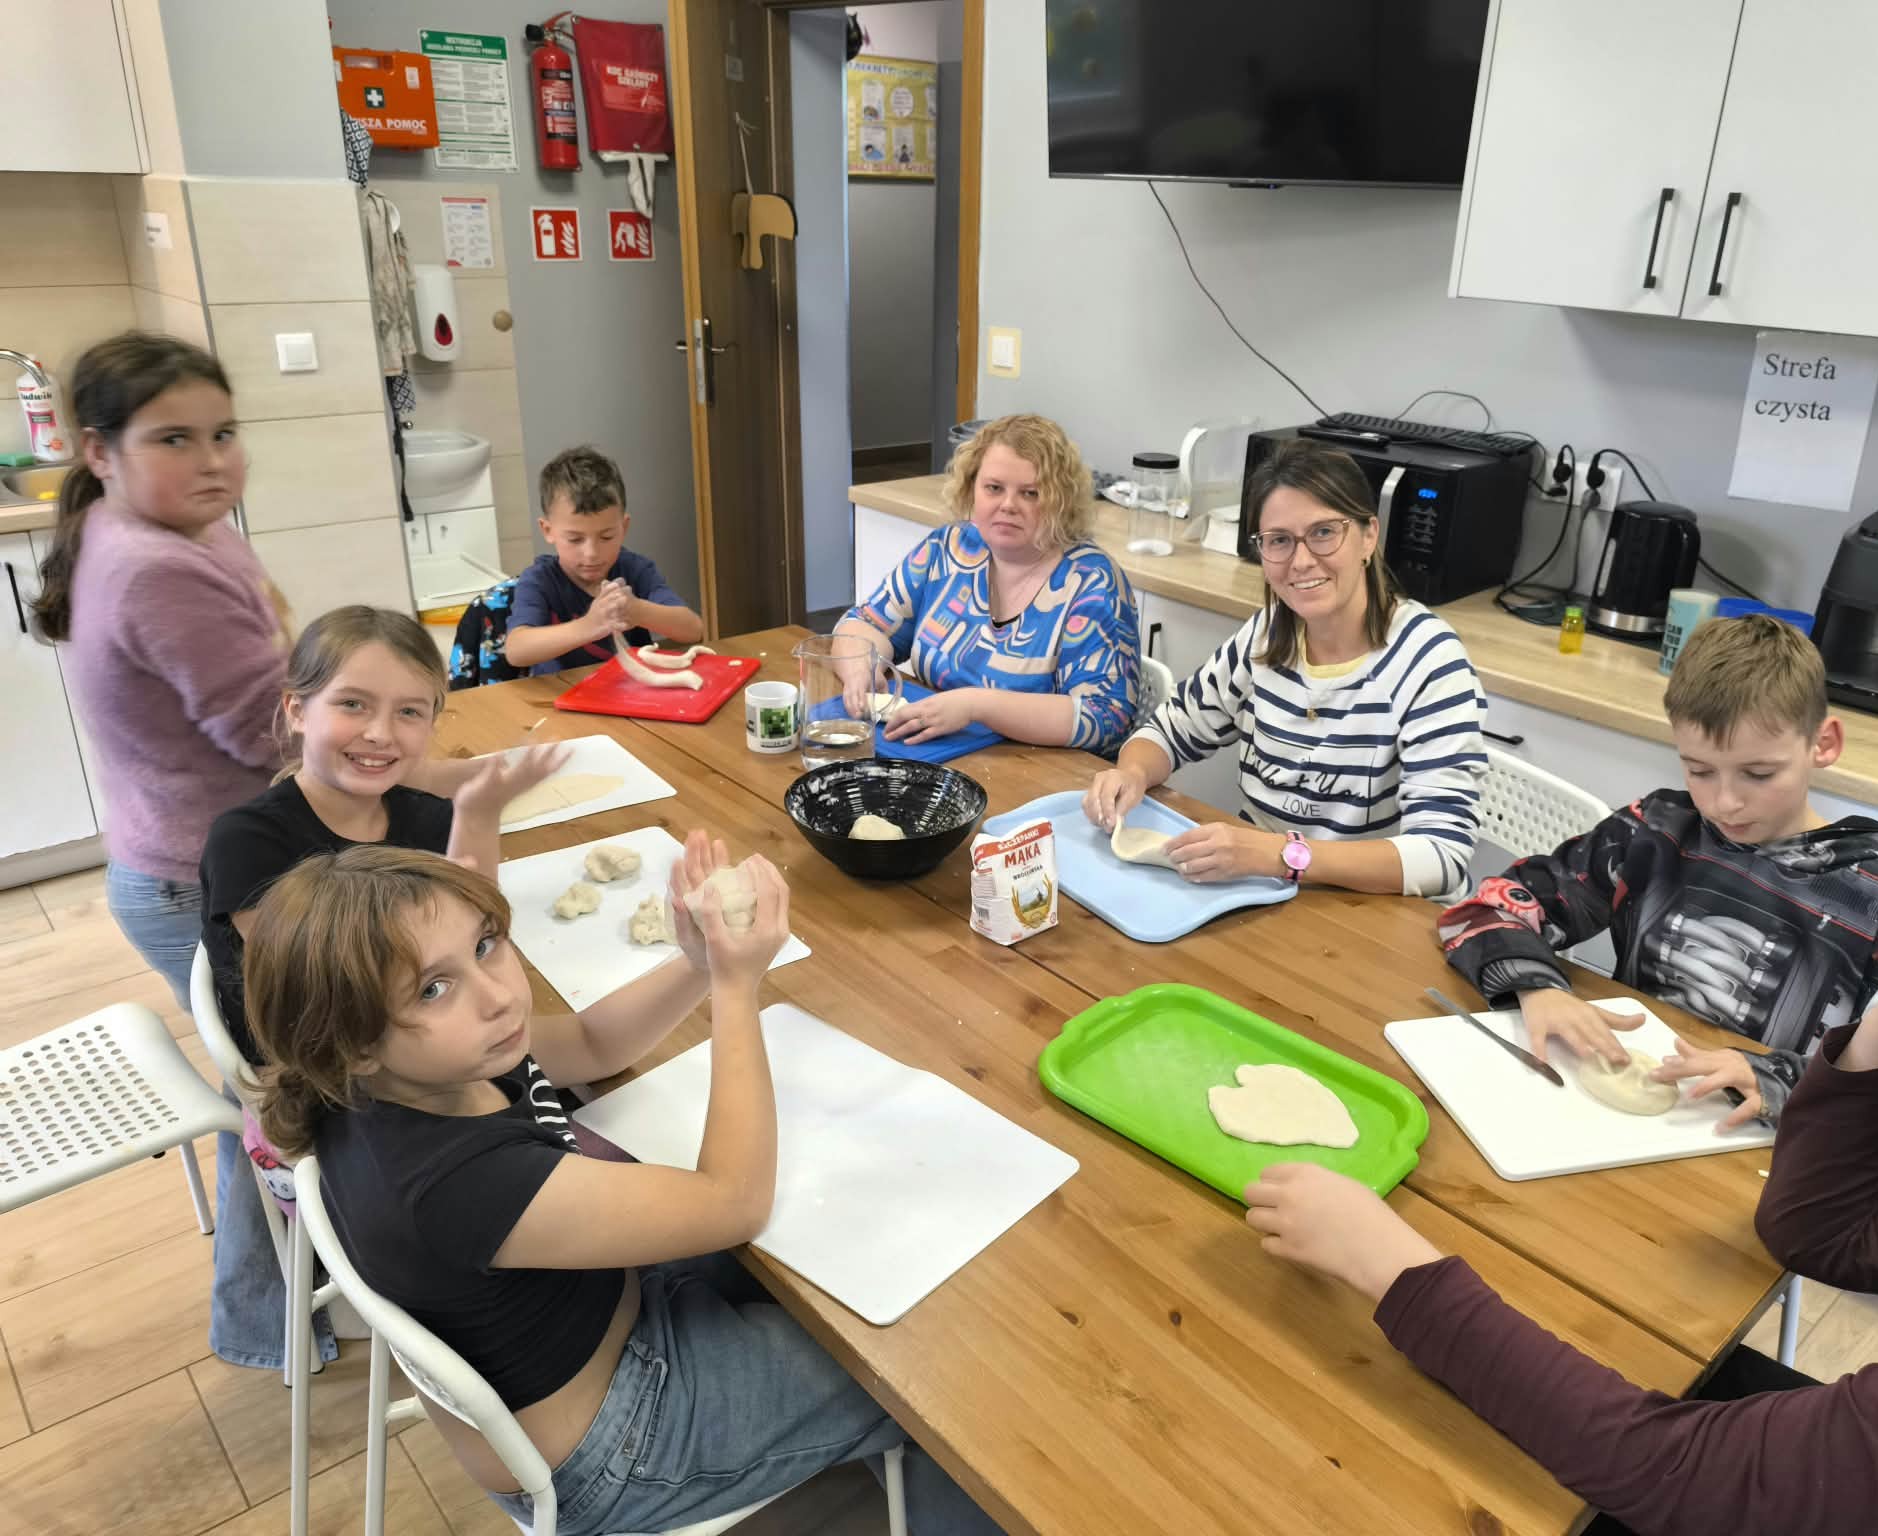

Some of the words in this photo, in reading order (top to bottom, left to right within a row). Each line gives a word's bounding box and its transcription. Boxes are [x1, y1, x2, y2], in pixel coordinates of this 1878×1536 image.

[385, 119, 427, 129] POMOC
[1763, 353, 1837, 380] Strefa
[1754, 399, 1831, 423] czysta
[1282, 795, 1321, 817] LOVE
[1004, 842, 1041, 868] MĄKA
